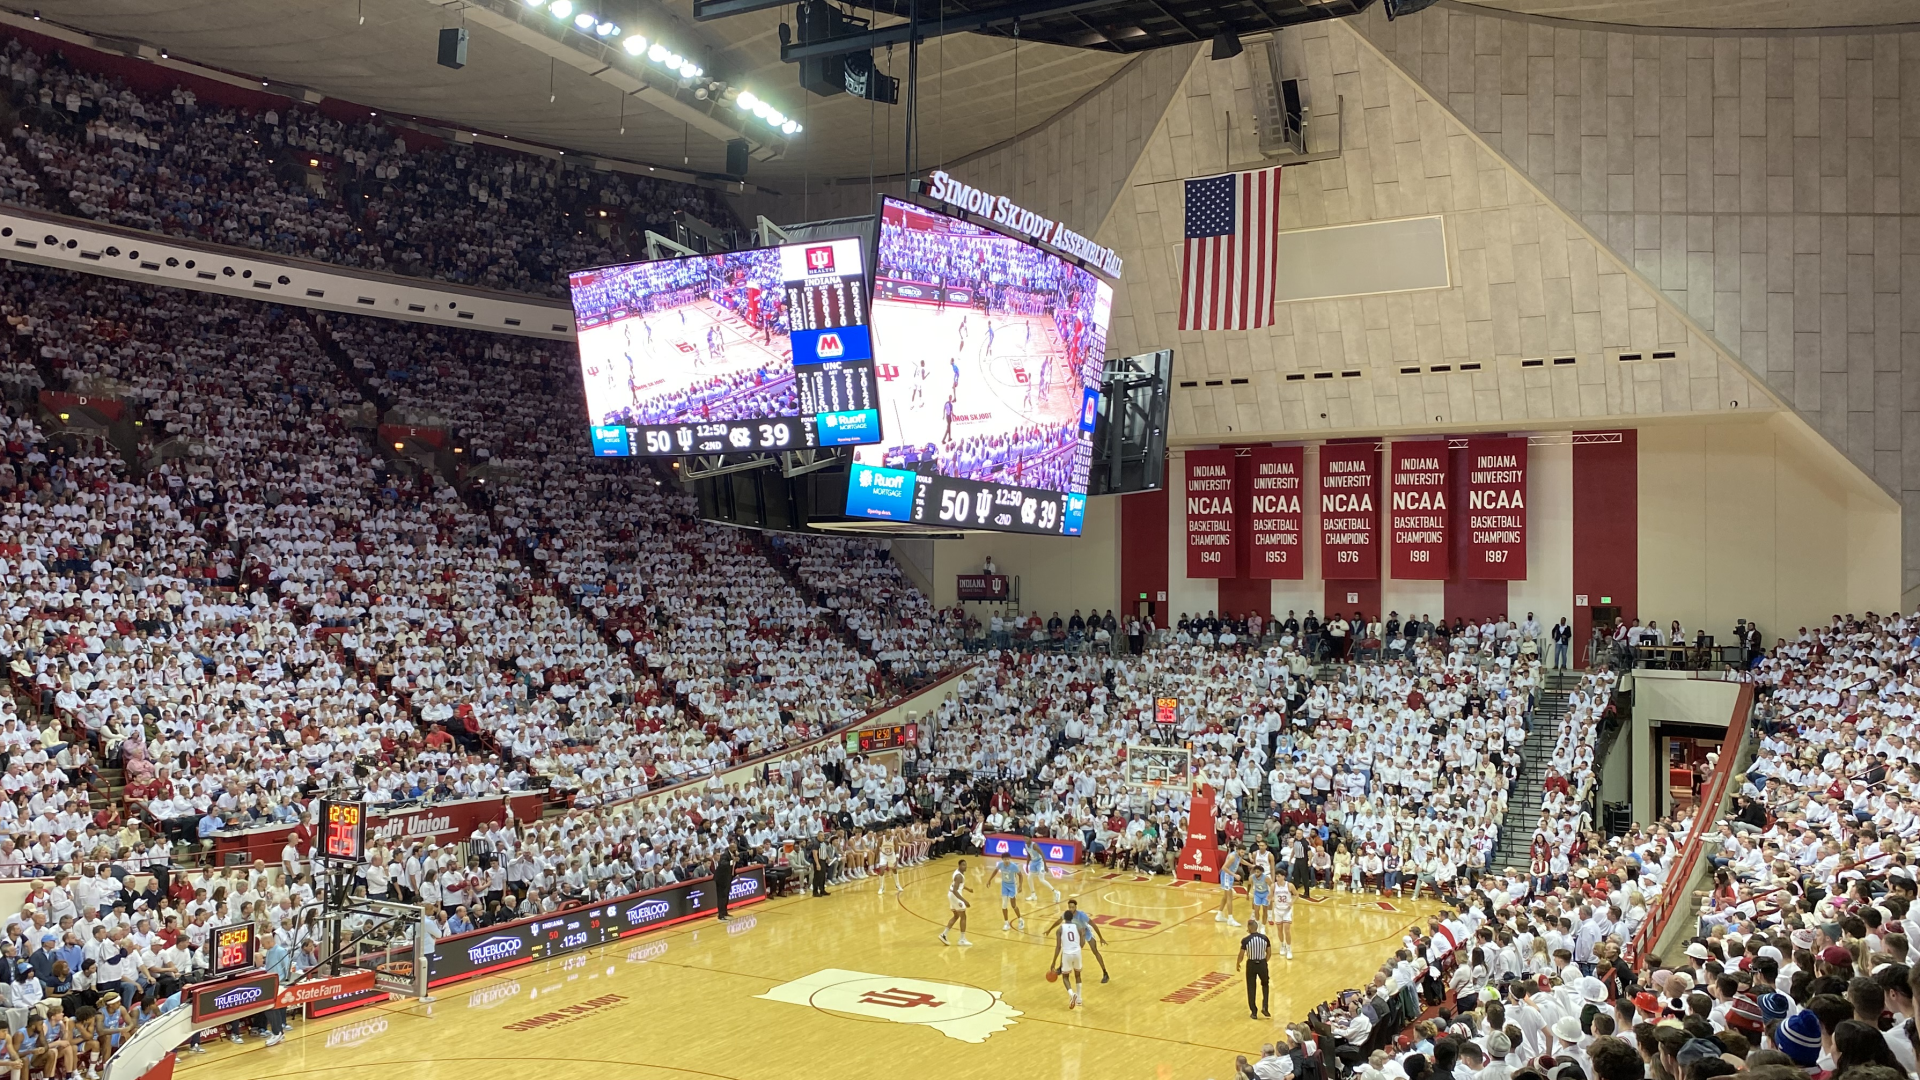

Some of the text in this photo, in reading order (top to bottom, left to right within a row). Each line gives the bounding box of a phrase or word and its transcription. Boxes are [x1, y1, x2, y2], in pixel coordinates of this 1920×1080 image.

[930, 171, 1123, 279] SIMON SKJODT ASSEMBLY HALL
[804, 276, 842, 286] INDIANA
[823, 362, 842, 370] UNC
[80, 397, 87, 405] D
[839, 414, 866, 424] Ruoff
[697, 424, 727, 436] 12:50
[805, 423, 811, 431] 3
[759, 423, 790, 446] 39
[646, 431, 670, 452] 50
[1330, 461, 1366, 473] INDIANA
[1401, 458, 1439, 470] INDIANA
[1478, 455, 1517, 468] INDIANA
[1194, 465, 1226, 477] INDIANA
[1260, 463, 1294, 475] INDIANA
[874, 473, 904, 488] Ruoff
[916, 475, 932, 484] FOULS
[1324, 475, 1371, 487] UNIVERSITY
[1395, 473, 1445, 485] UNIVERSITY
[1472, 470, 1522, 484] UNIVERSITY
[1189, 479, 1231, 491] UNIVERSITY
[1254, 478, 1299, 489] UNIVERSITY
[873, 488, 902, 497] MORTGAGE
[918, 485, 925, 497] 2
[995, 488, 1022, 507] 12:50
[1323, 494, 1373, 512] NCAA
[1393, 491, 1446, 510] NCAA
[1470, 490, 1524, 509] NCAA
[940, 490, 969, 521] 50
[1188, 497, 1233, 514] NCAA
[1253, 496, 1301, 513] NCAA
[915, 507, 923, 519] 3
[1038, 500, 1056, 528] 39
[1189, 520, 1231, 531] BASKETBALL
[1254, 519, 1299, 531] BASKETBALL
[1324, 518, 1371, 530] BASKETBALL
[1395, 516, 1444, 528] BASKETBALL
[1471, 516, 1522, 528] BASKETBALL
[1191, 534, 1230, 545] CHAMPIONS
[1256, 534, 1297, 545] CHAMPIONS
[1326, 533, 1369, 544] CHAMPIONS
[1396, 531, 1442, 543] CHAMPIONS
[1473, 531, 1520, 543] CHAMPIONS
[1201, 552, 1220, 562] 1940
[1266, 551, 1286, 562] 1953
[1338, 551, 1358, 562] 1976
[1410, 550, 1429, 562] 1981
[1486, 550, 1508, 562] 1987
[959, 579, 986, 588] INDIANA
[329, 806, 358, 824] 12:50
[408, 812, 450, 834] Union
[328, 824, 354, 855] 25
[1191, 833, 1206, 841] meijer
[1184, 864, 1212, 872] Smithville
[737, 890, 755, 898] ESTATE
[589, 910, 600, 918] UNC
[626, 902, 669, 921] TRUEBLOOD
[646, 912, 665, 922] ESTATE
[542, 920, 564, 929] INDIANA
[567, 922, 580, 930] 2ND
[591, 920, 599, 928] 39
[220, 928, 248, 945] 12:50
[549, 931, 558, 940] 50
[1068, 932, 1074, 941] 0
[468, 939, 521, 961] TRUEBLOOD
[222, 947, 242, 966] 25
[493, 951, 517, 962] ESTATE
[214, 988, 262, 1007] TRUEBLOOD
[502, 994, 629, 1031] SIMON SKJODT
